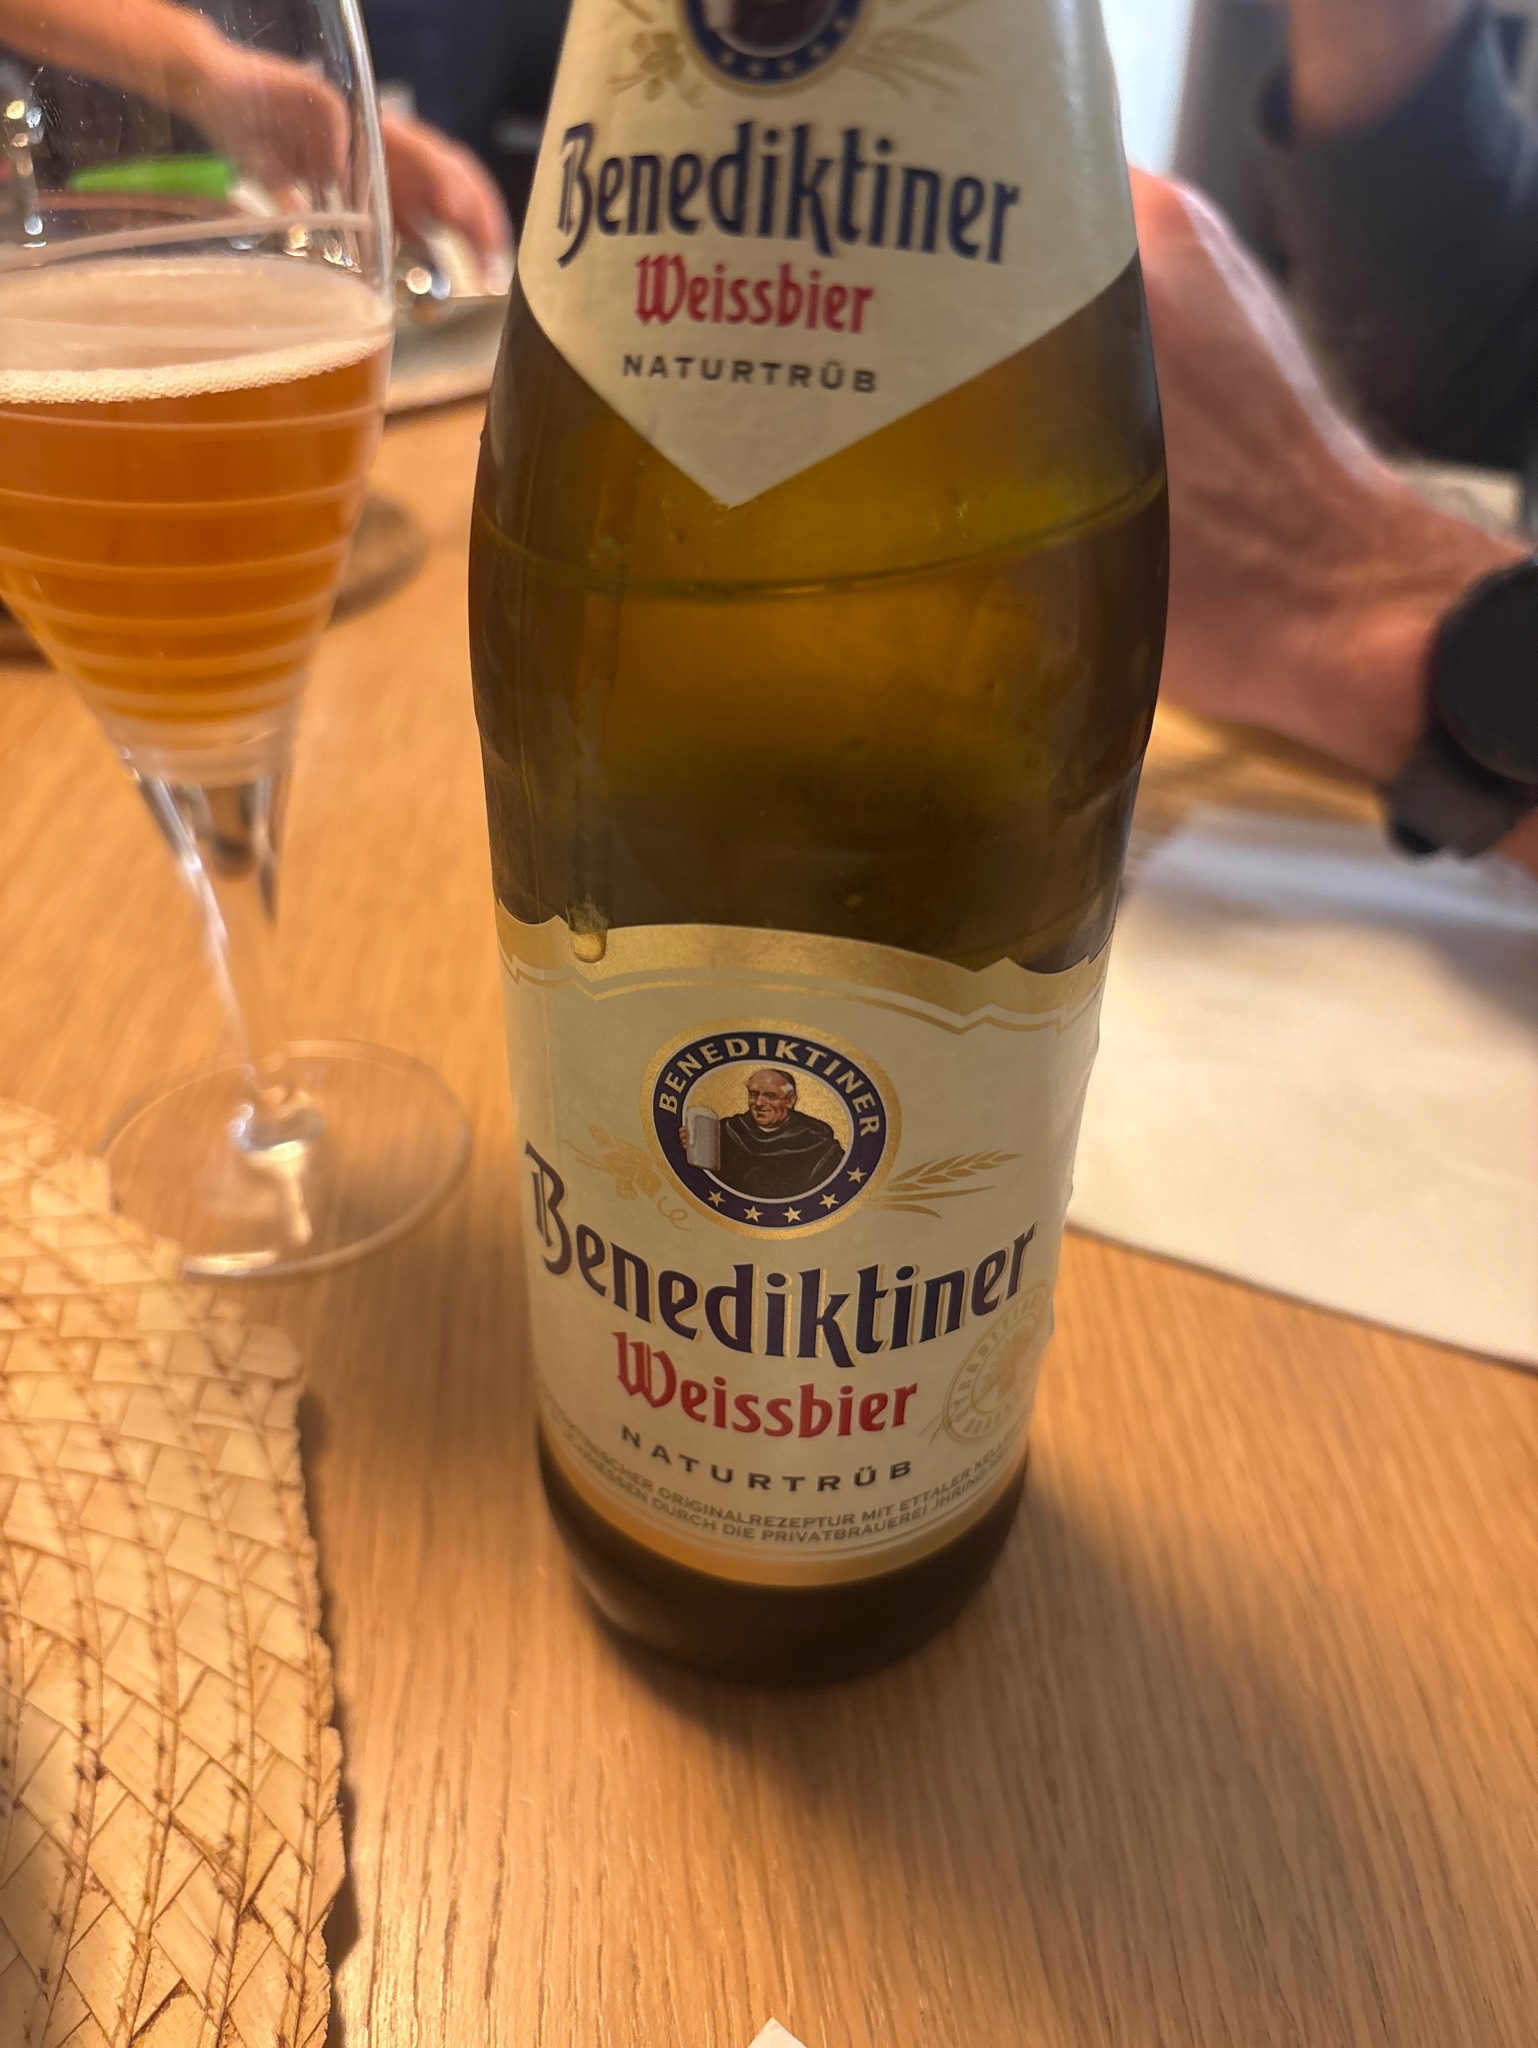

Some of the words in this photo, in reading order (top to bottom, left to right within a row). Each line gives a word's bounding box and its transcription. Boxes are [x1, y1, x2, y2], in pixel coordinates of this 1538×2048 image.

[557, 121, 1020, 269] Benediktiner
[635, 252, 873, 334] Weissbier
[622, 353, 878, 393] NATURTRÜB
[658, 1037, 880, 1136] BENEDIKTINER
[525, 1140, 1036, 1368] Benediktiner
[611, 1331, 919, 1438] Weissbier
[621, 1424, 912, 1492] NATURTRÜB
[658, 1486, 855, 1528] ORIGINALREZEPTUR
[861, 1504, 894, 1522] MIT
[899, 1467, 971, 1511] ETTALER
[652, 1498, 717, 1531] DURCH
[722, 1524, 754, 1539] DIE
[762, 1504, 927, 1542] PRIVATBRAUEREI
